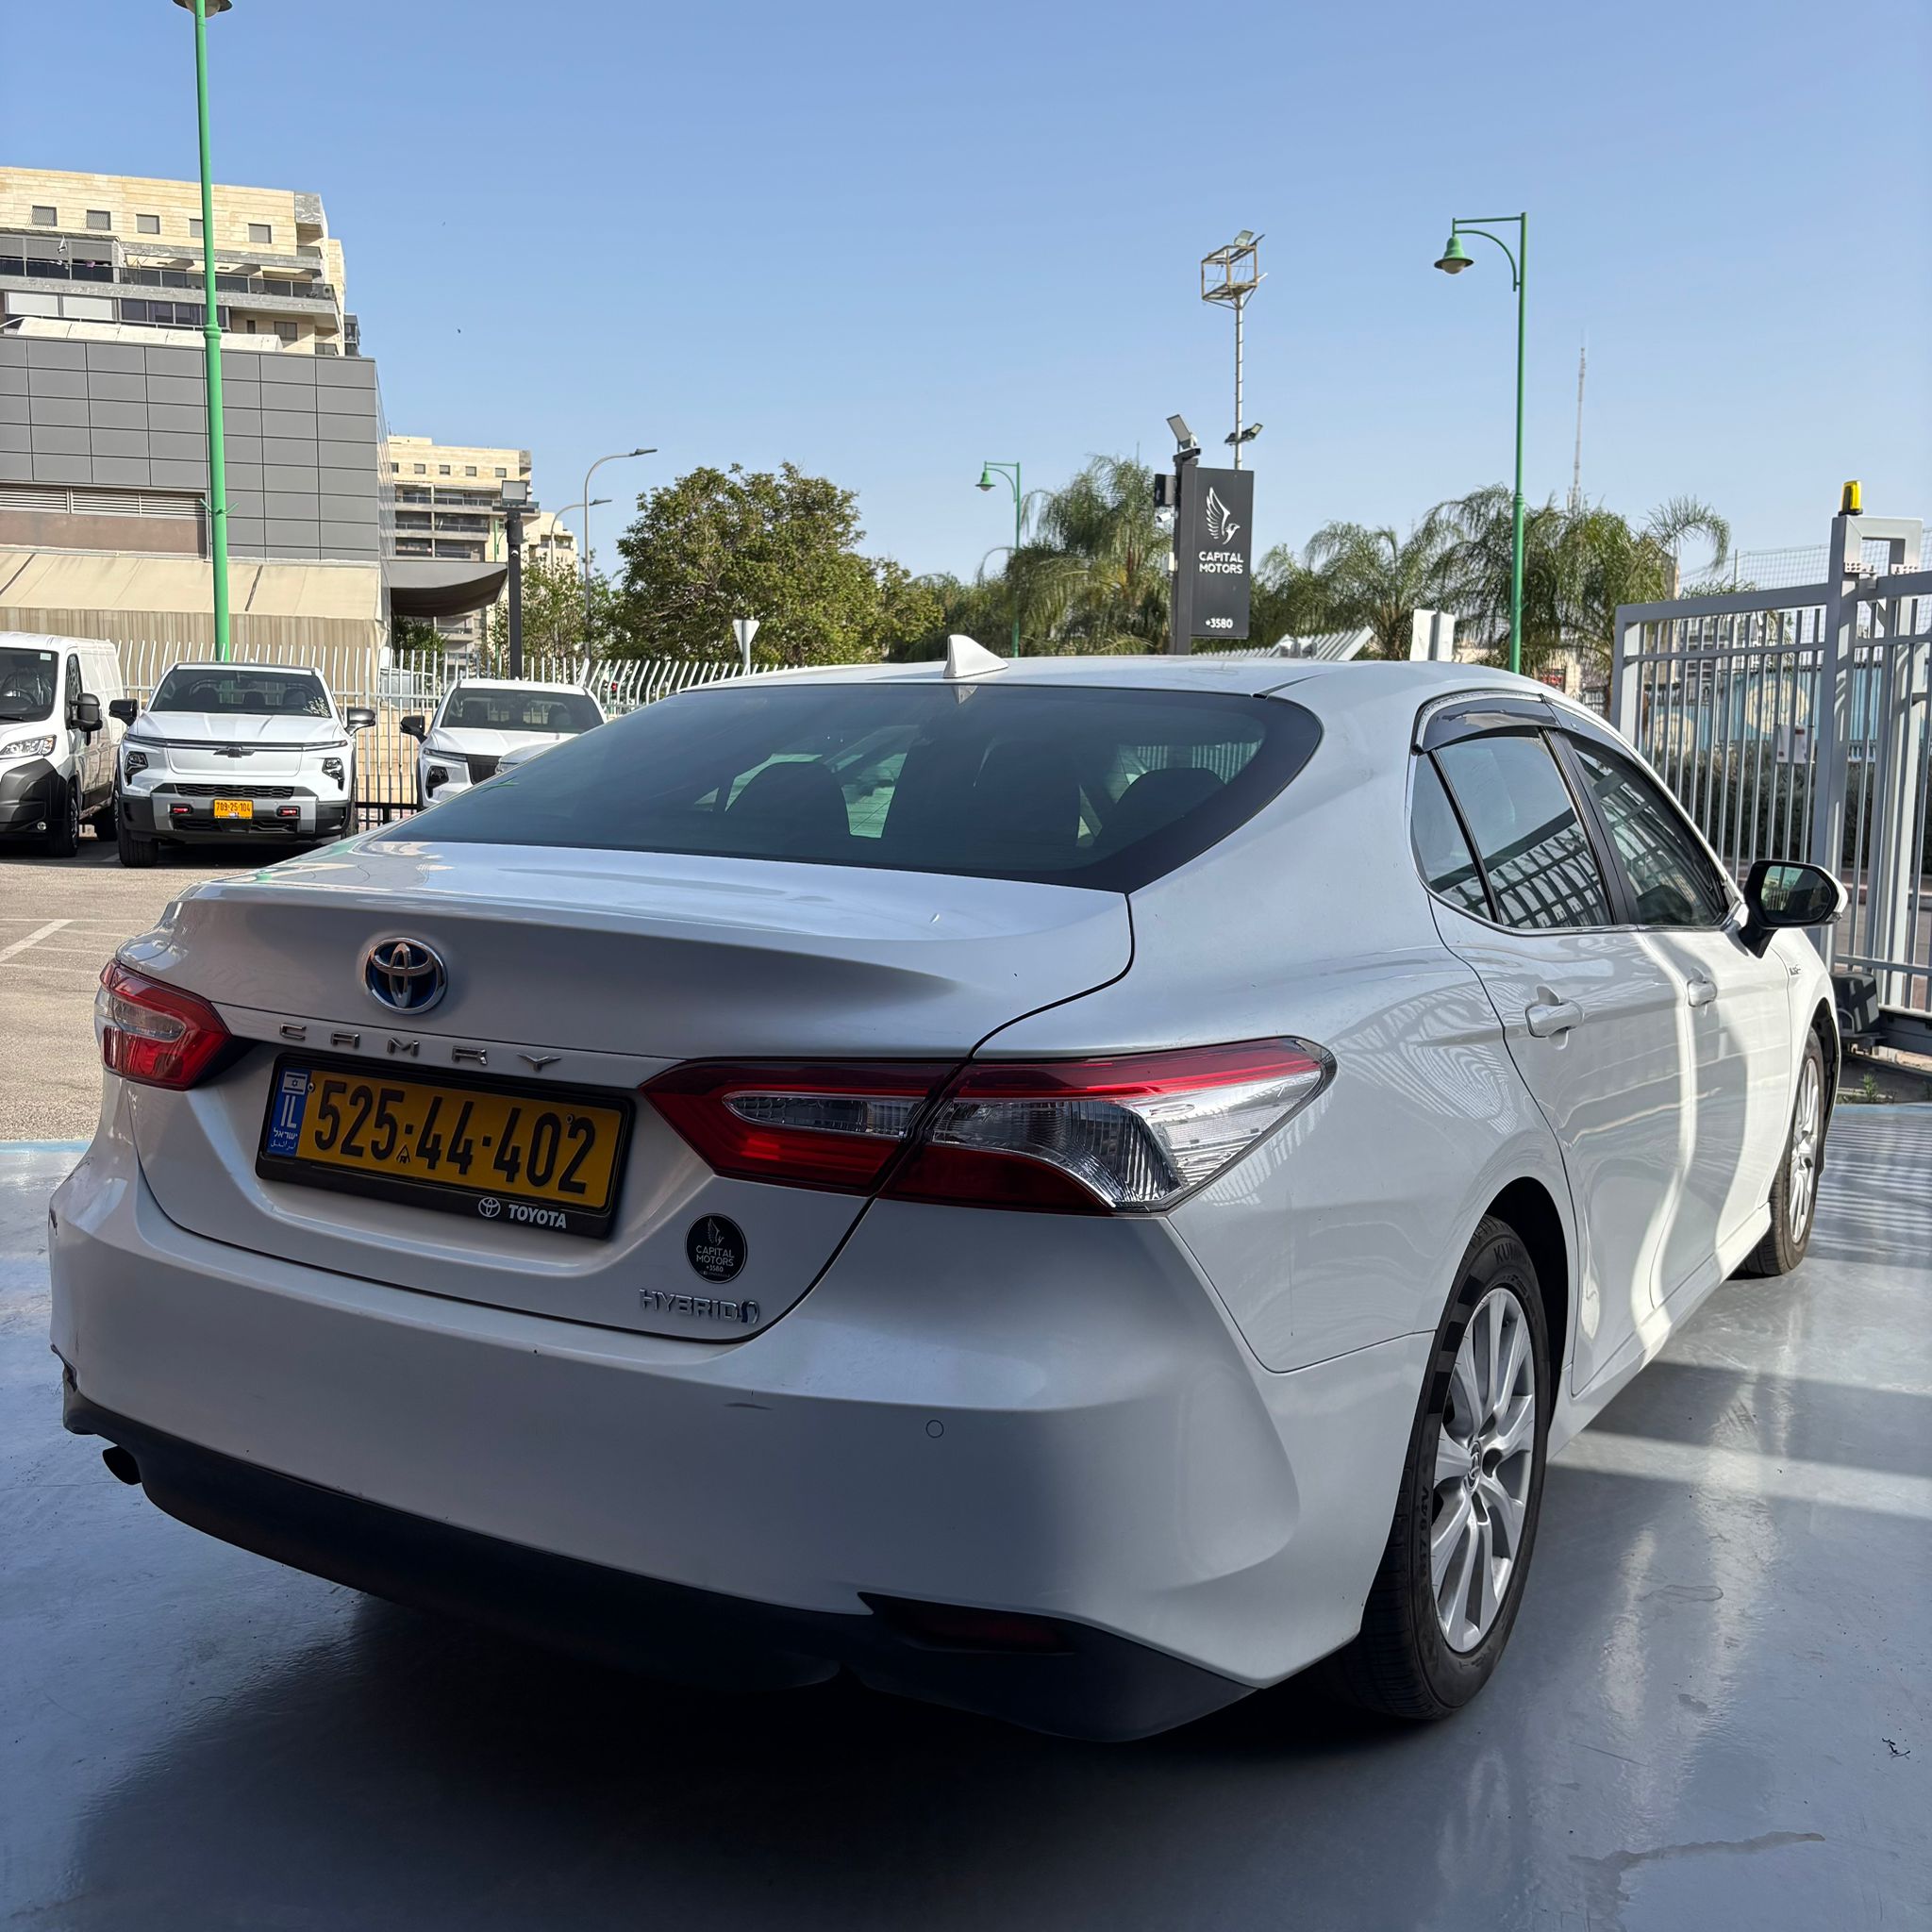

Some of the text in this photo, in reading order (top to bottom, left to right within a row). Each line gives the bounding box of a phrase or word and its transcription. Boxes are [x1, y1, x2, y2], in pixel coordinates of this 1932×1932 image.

[1198, 551, 1244, 563] CAPITAL
[1199, 563, 1243, 575] MOTORS
[280, 1022, 562, 1073] CAMRY
[280, 1094, 297, 1129] IL
[273, 1126, 298, 1141] ישראל
[508, 1204, 567, 1229] TOYOTA
[695, 1244, 735, 1258] CAPITAL
[695, 1254, 734, 1267] MOTORS
[639, 1289, 739, 1322] HYBRID
